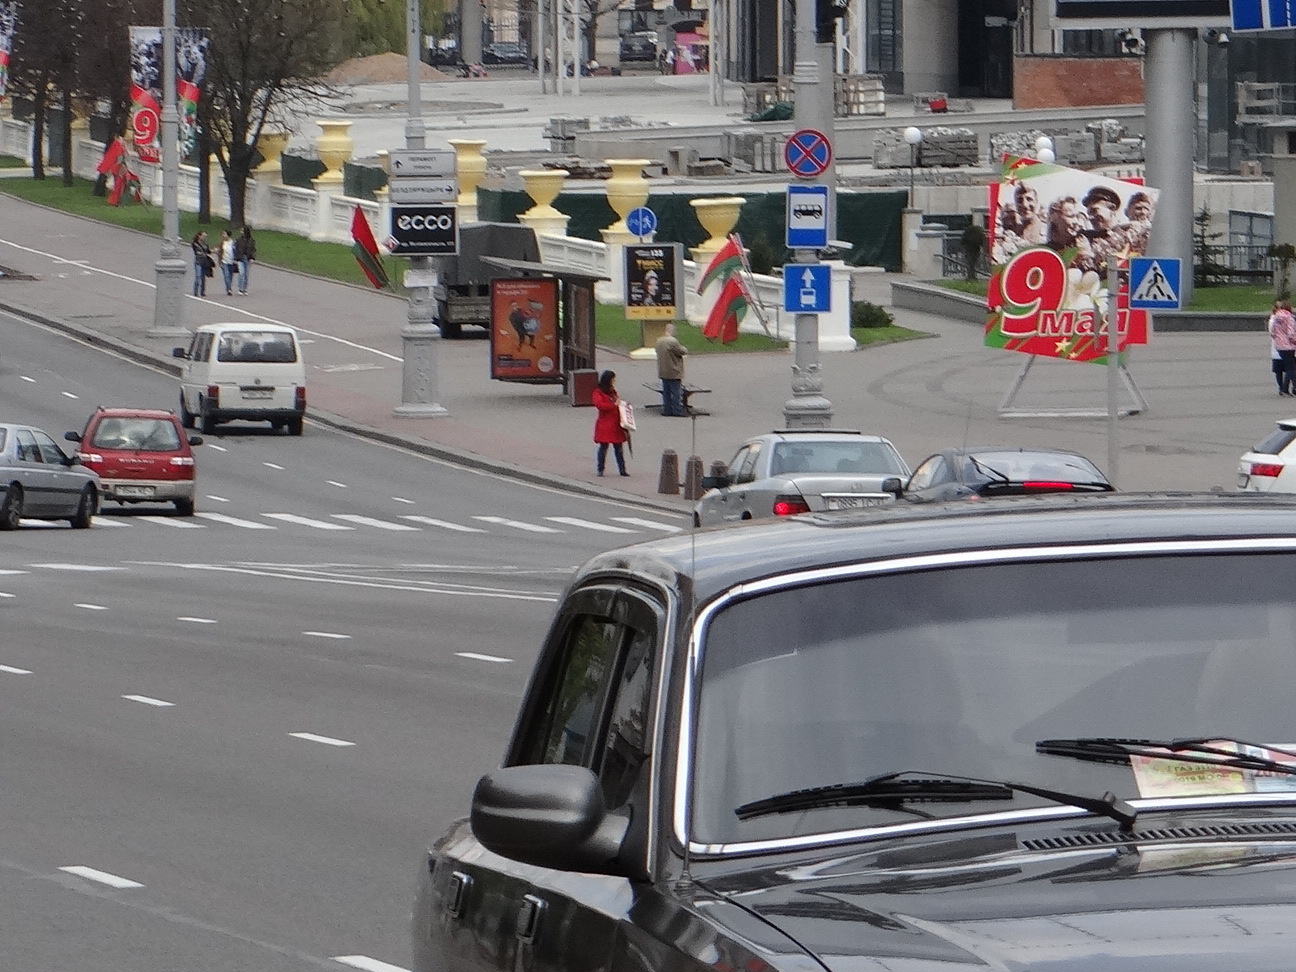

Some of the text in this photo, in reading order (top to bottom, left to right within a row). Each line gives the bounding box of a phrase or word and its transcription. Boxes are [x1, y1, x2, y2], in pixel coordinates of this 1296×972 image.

[133, 108, 159, 145] 9
[397, 215, 452, 231] ecco
[1001, 248, 1066, 338] 9
